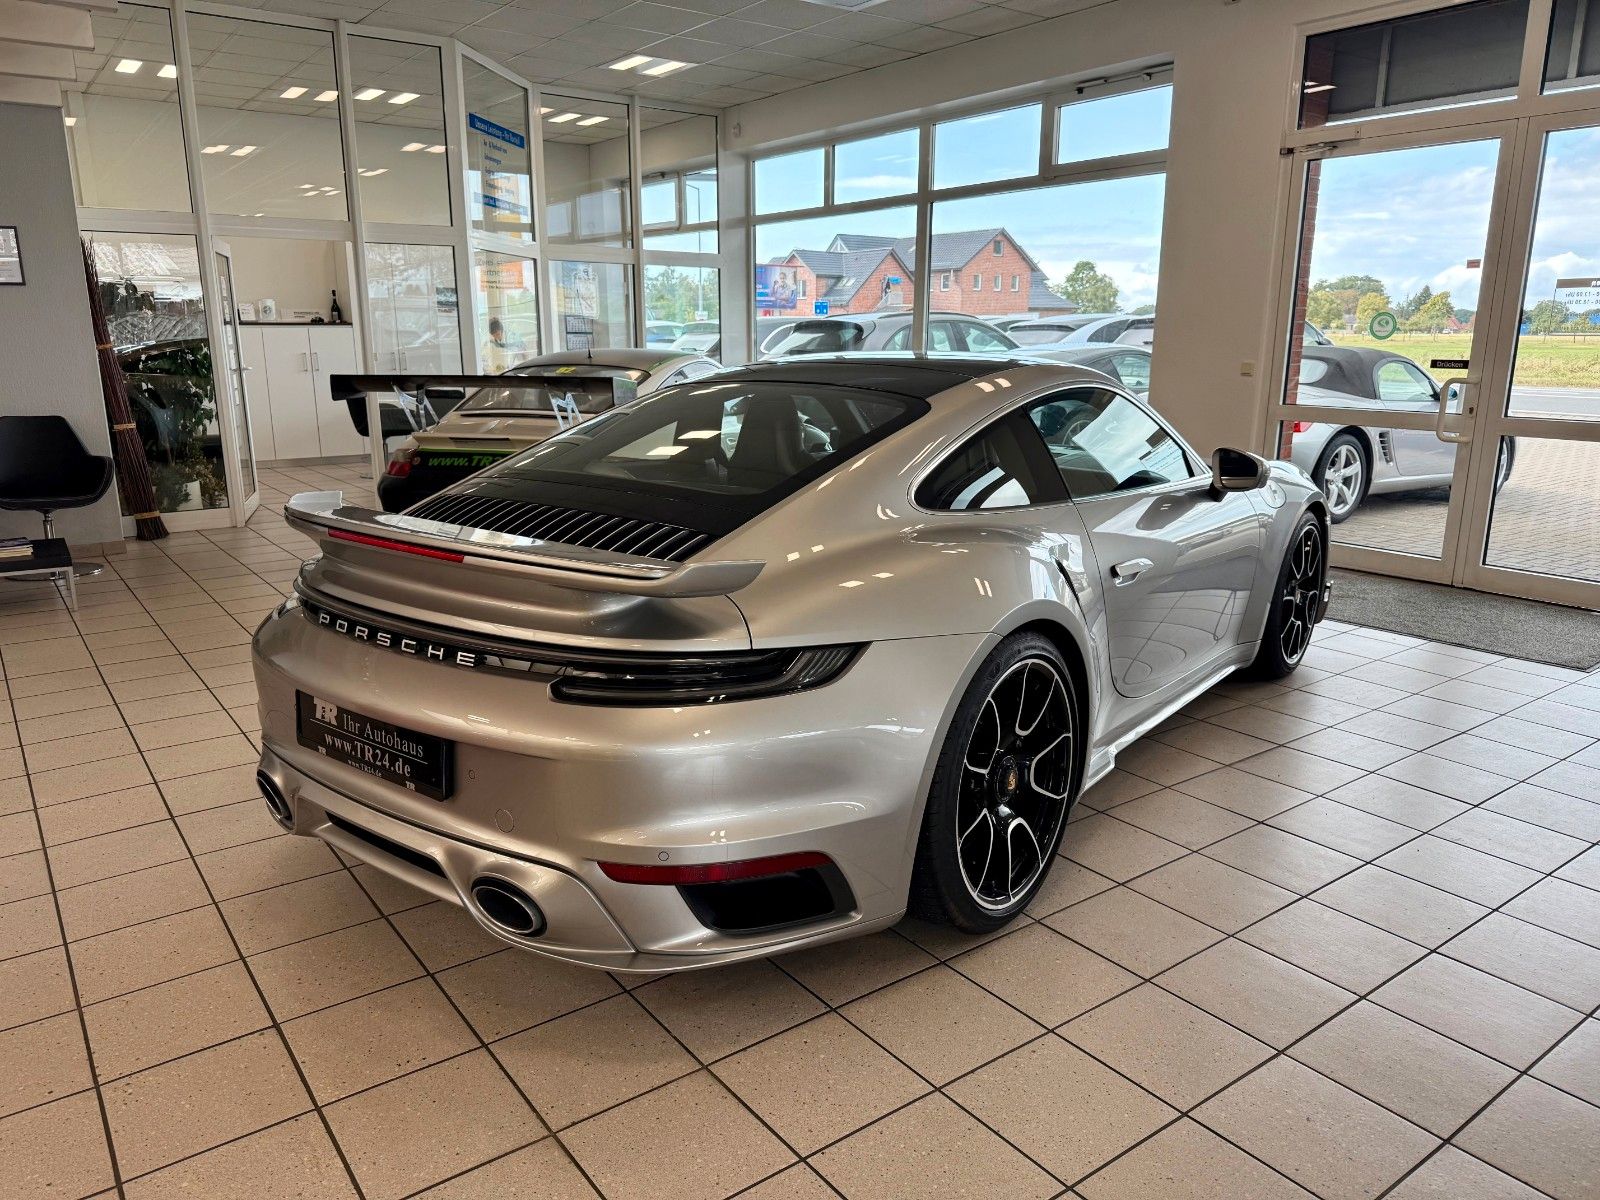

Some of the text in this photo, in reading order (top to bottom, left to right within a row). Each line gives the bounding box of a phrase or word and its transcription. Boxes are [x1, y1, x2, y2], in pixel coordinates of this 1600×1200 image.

[319, 613, 475, 667] PORSCHE
[324, 733, 412, 778] www.TR24.de
[343, 713, 361, 734] Ihr
[364, 722, 424, 758] Autohaus
